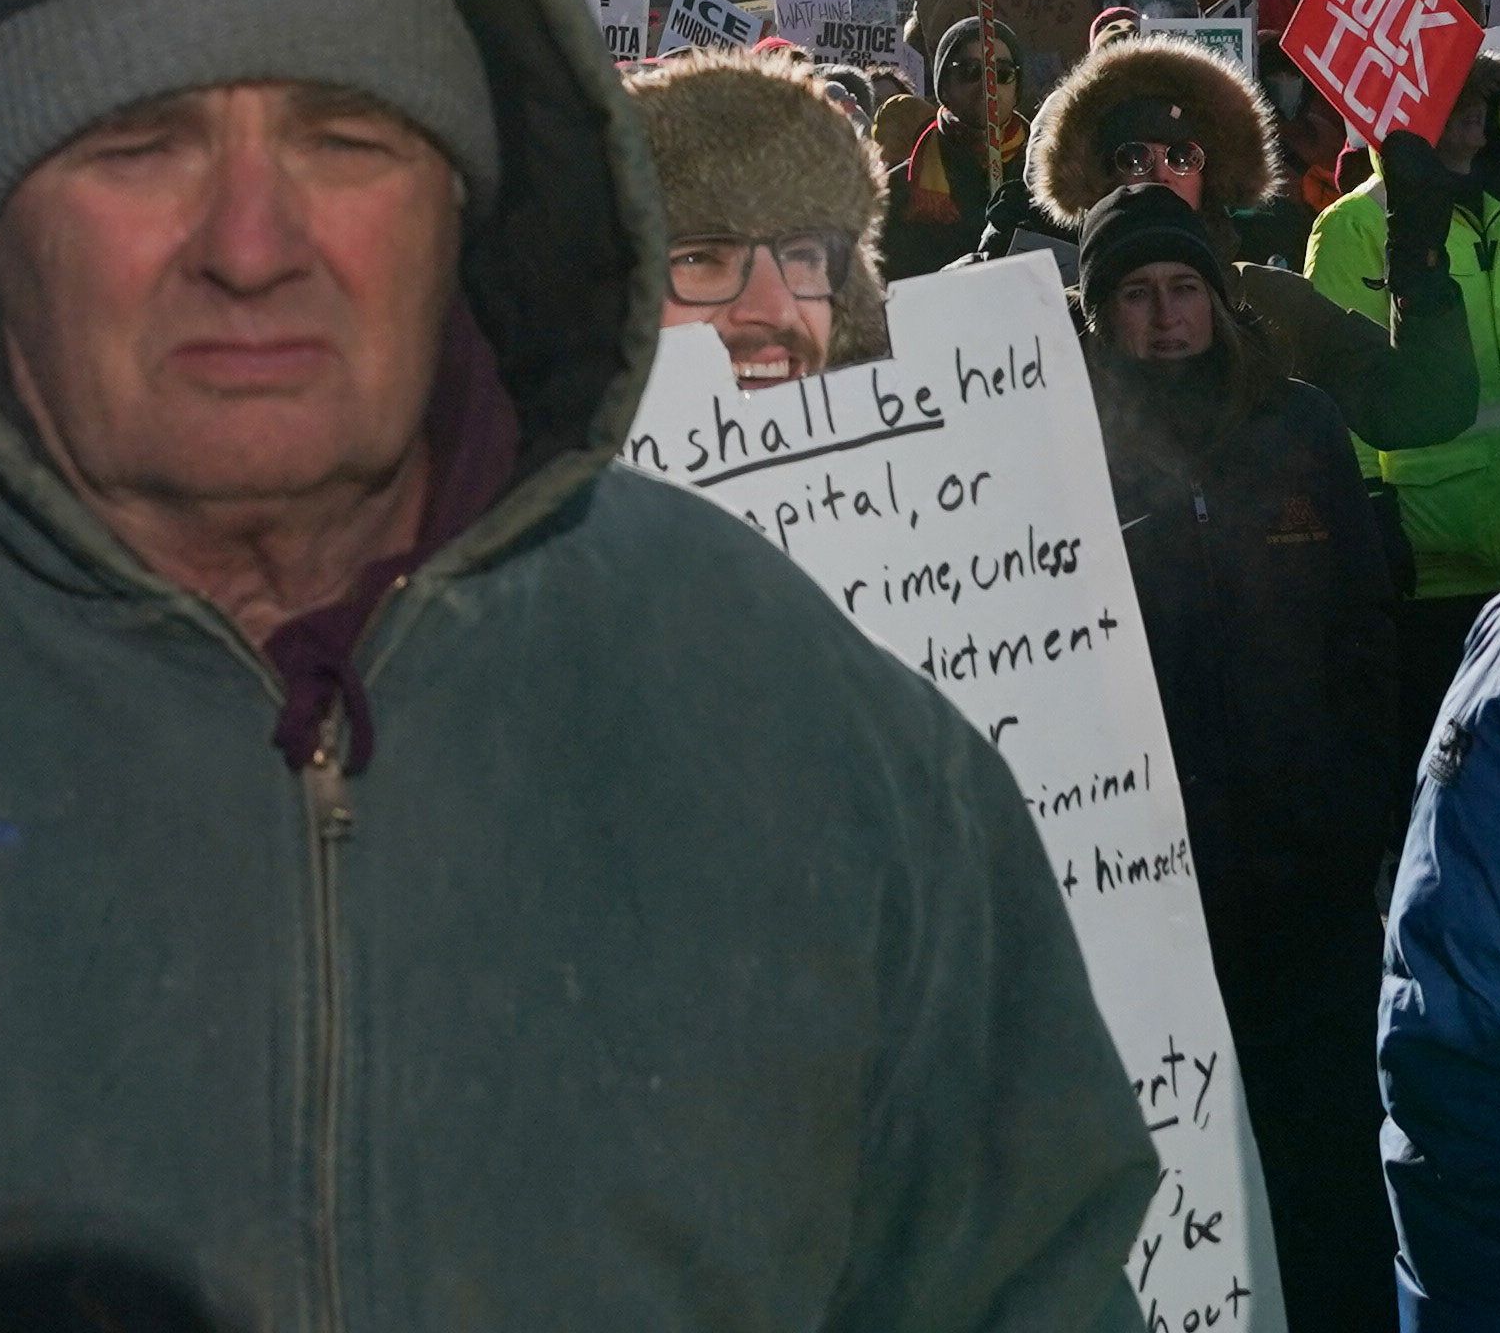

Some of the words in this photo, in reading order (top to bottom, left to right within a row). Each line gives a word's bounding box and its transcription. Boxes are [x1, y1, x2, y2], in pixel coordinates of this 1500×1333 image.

[815, 21, 897, 54] JUSTICE
[1302, 1, 1423, 143] ICE
[686, 374, 835, 471] shall
[872, 368, 943, 428] be
[955, 335, 1047, 403] held
[744, 461, 920, 552] pital,
[937, 470, 992, 512] or
[843, 564, 963, 615] rime,
[921, 607, 1118, 680] dictment
